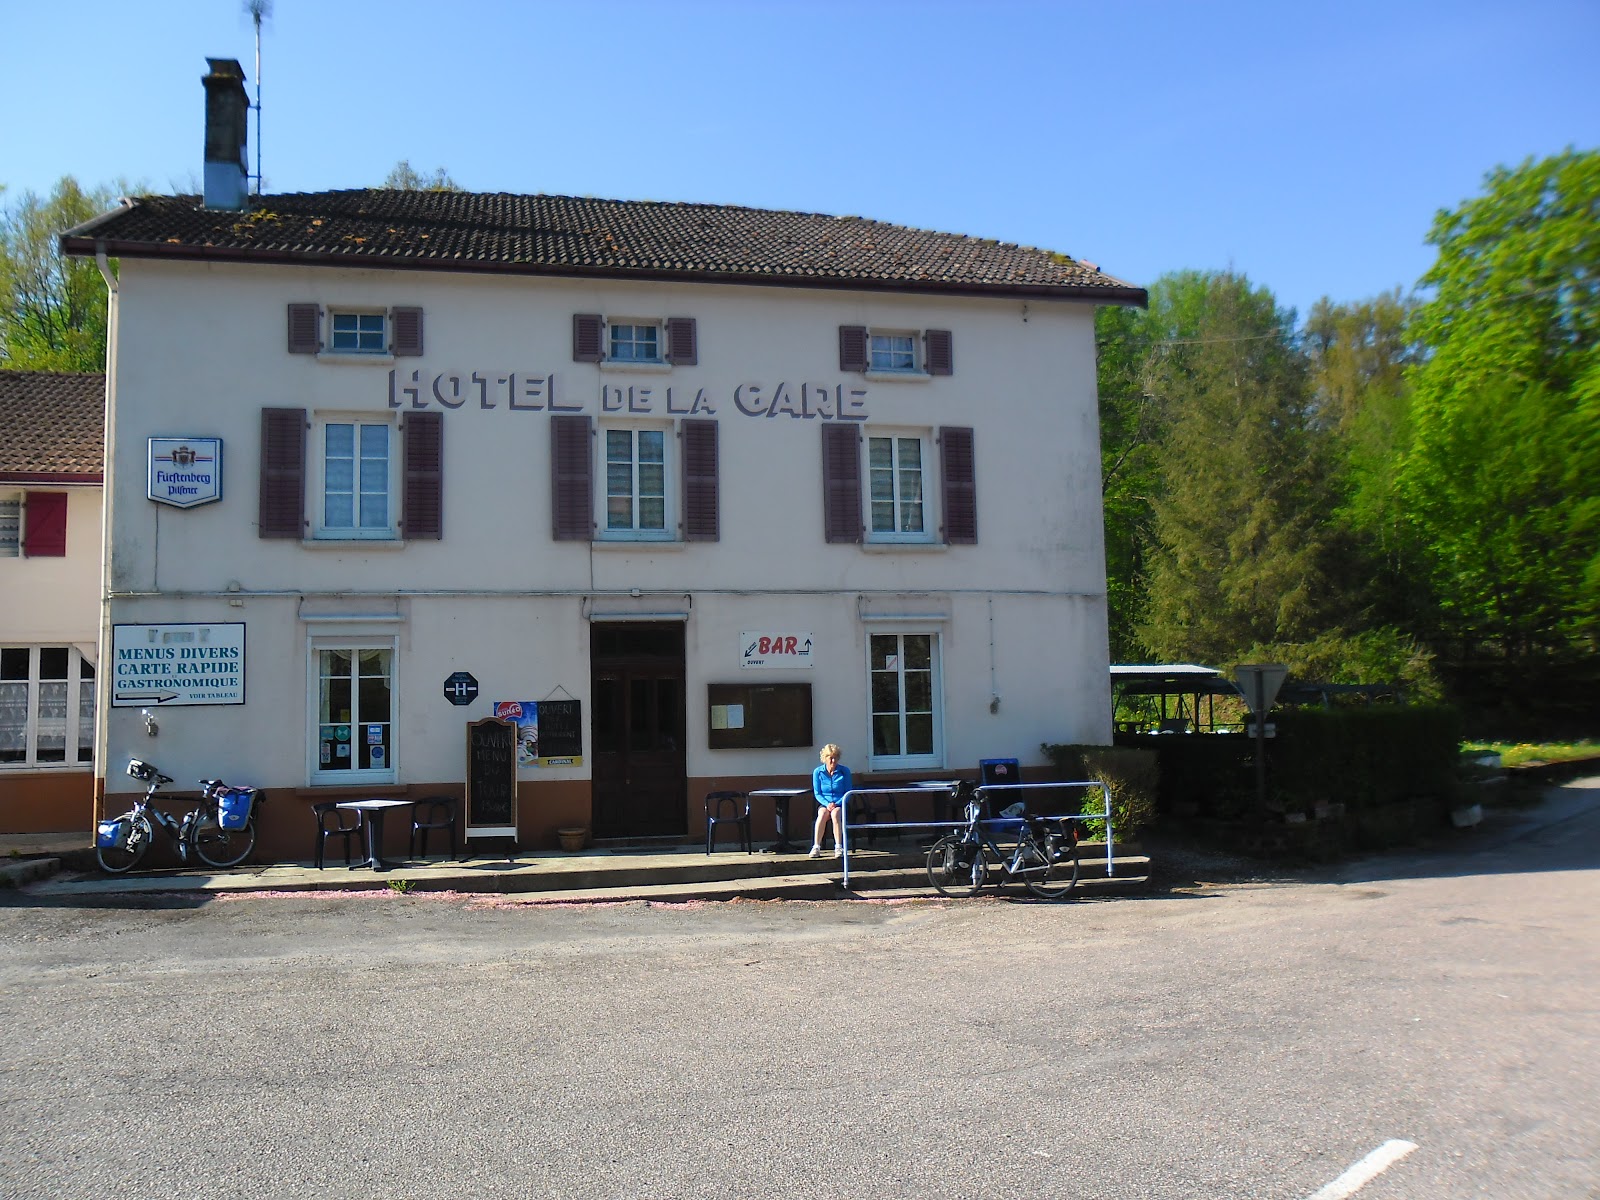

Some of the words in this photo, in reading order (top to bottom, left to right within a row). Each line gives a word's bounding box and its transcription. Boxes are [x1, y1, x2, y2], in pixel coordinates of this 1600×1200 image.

[388, 369, 584, 412] HOTEL
[602, 384, 653, 413] DE
[666, 387, 717, 415] LA
[733, 381, 869, 421] GARE
[118, 647, 175, 660] MENUS
[180, 646, 239, 659] DIVERS
[758, 636, 798, 655] BAR
[117, 663, 171, 676] CARTE
[177, 661, 239, 674] RAPIDE
[117, 677, 238, 689] GASTRONOMIQUE
